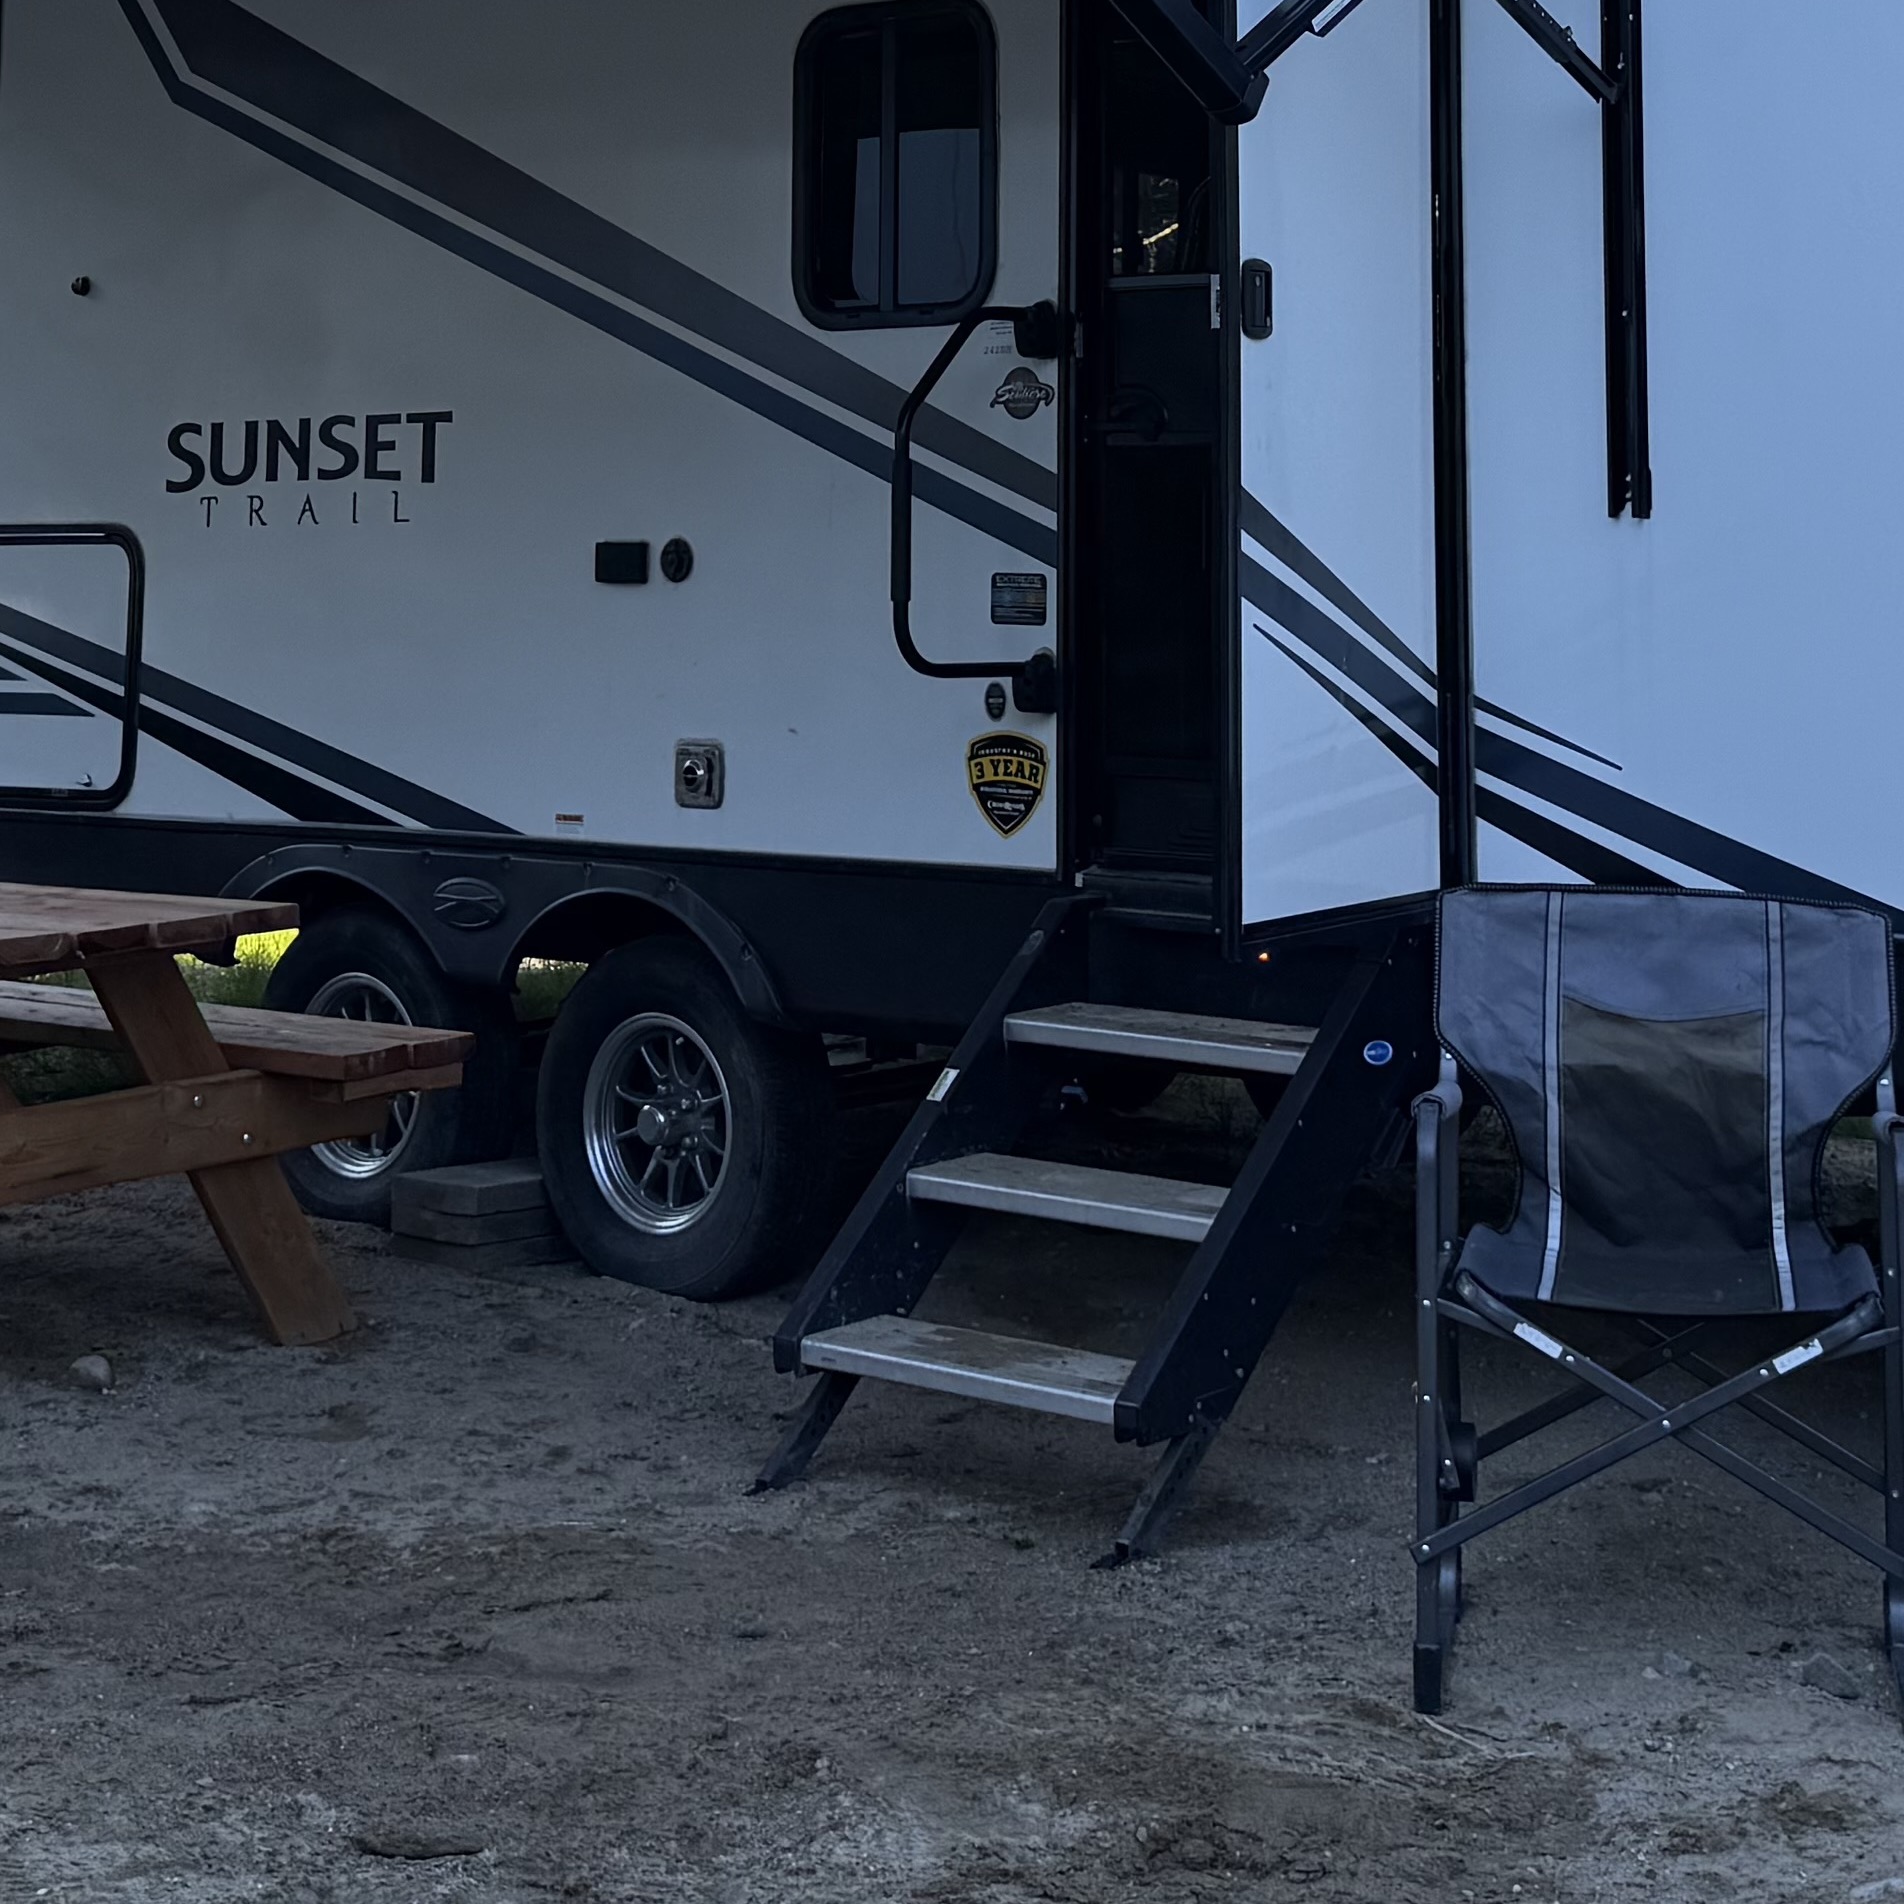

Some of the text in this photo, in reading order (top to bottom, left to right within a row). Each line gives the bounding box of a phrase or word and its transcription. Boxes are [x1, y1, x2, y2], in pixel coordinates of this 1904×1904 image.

[165, 410, 454, 494] SUNSET
[199, 490, 411, 528] TRAIL
[973, 757, 1041, 784] 3 YEAR
